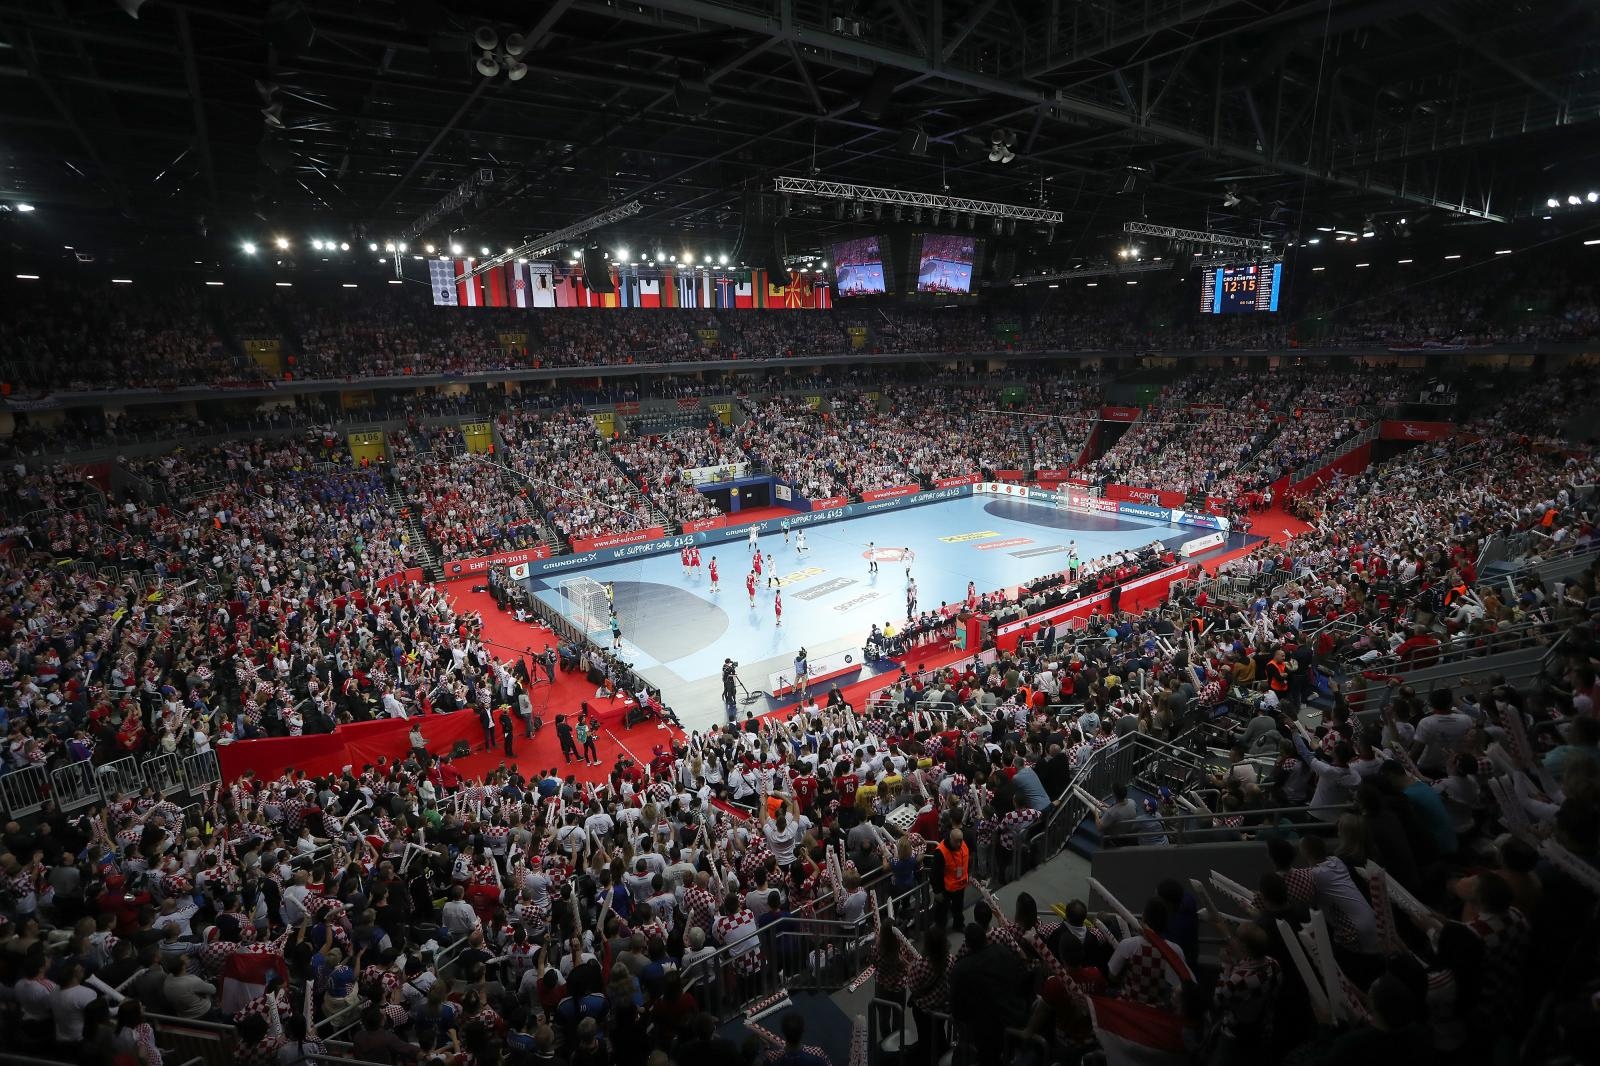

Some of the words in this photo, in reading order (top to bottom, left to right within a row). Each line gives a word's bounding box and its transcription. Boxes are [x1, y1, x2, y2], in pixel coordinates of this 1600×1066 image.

[1224, 280, 1256, 292] 12:15
[363, 434, 379, 442] 106
[867, 501, 895, 510] GRUNDFOS
[1120, 506, 1161, 518] GRUNDFOS
[791, 514, 812, 525] SUPPORT
[613, 549, 625, 558] WE
[626, 543, 655, 555] SUPPORT
[656, 541, 673, 550] GOAL
[470, 562, 485, 570] EHF
[508, 554, 529, 563] 2018
[542, 557, 589, 570] GRUNDFOS
[801, 785, 808, 794] 9
[845, 783, 855, 793] 18
[455, 861, 462, 873] 9
